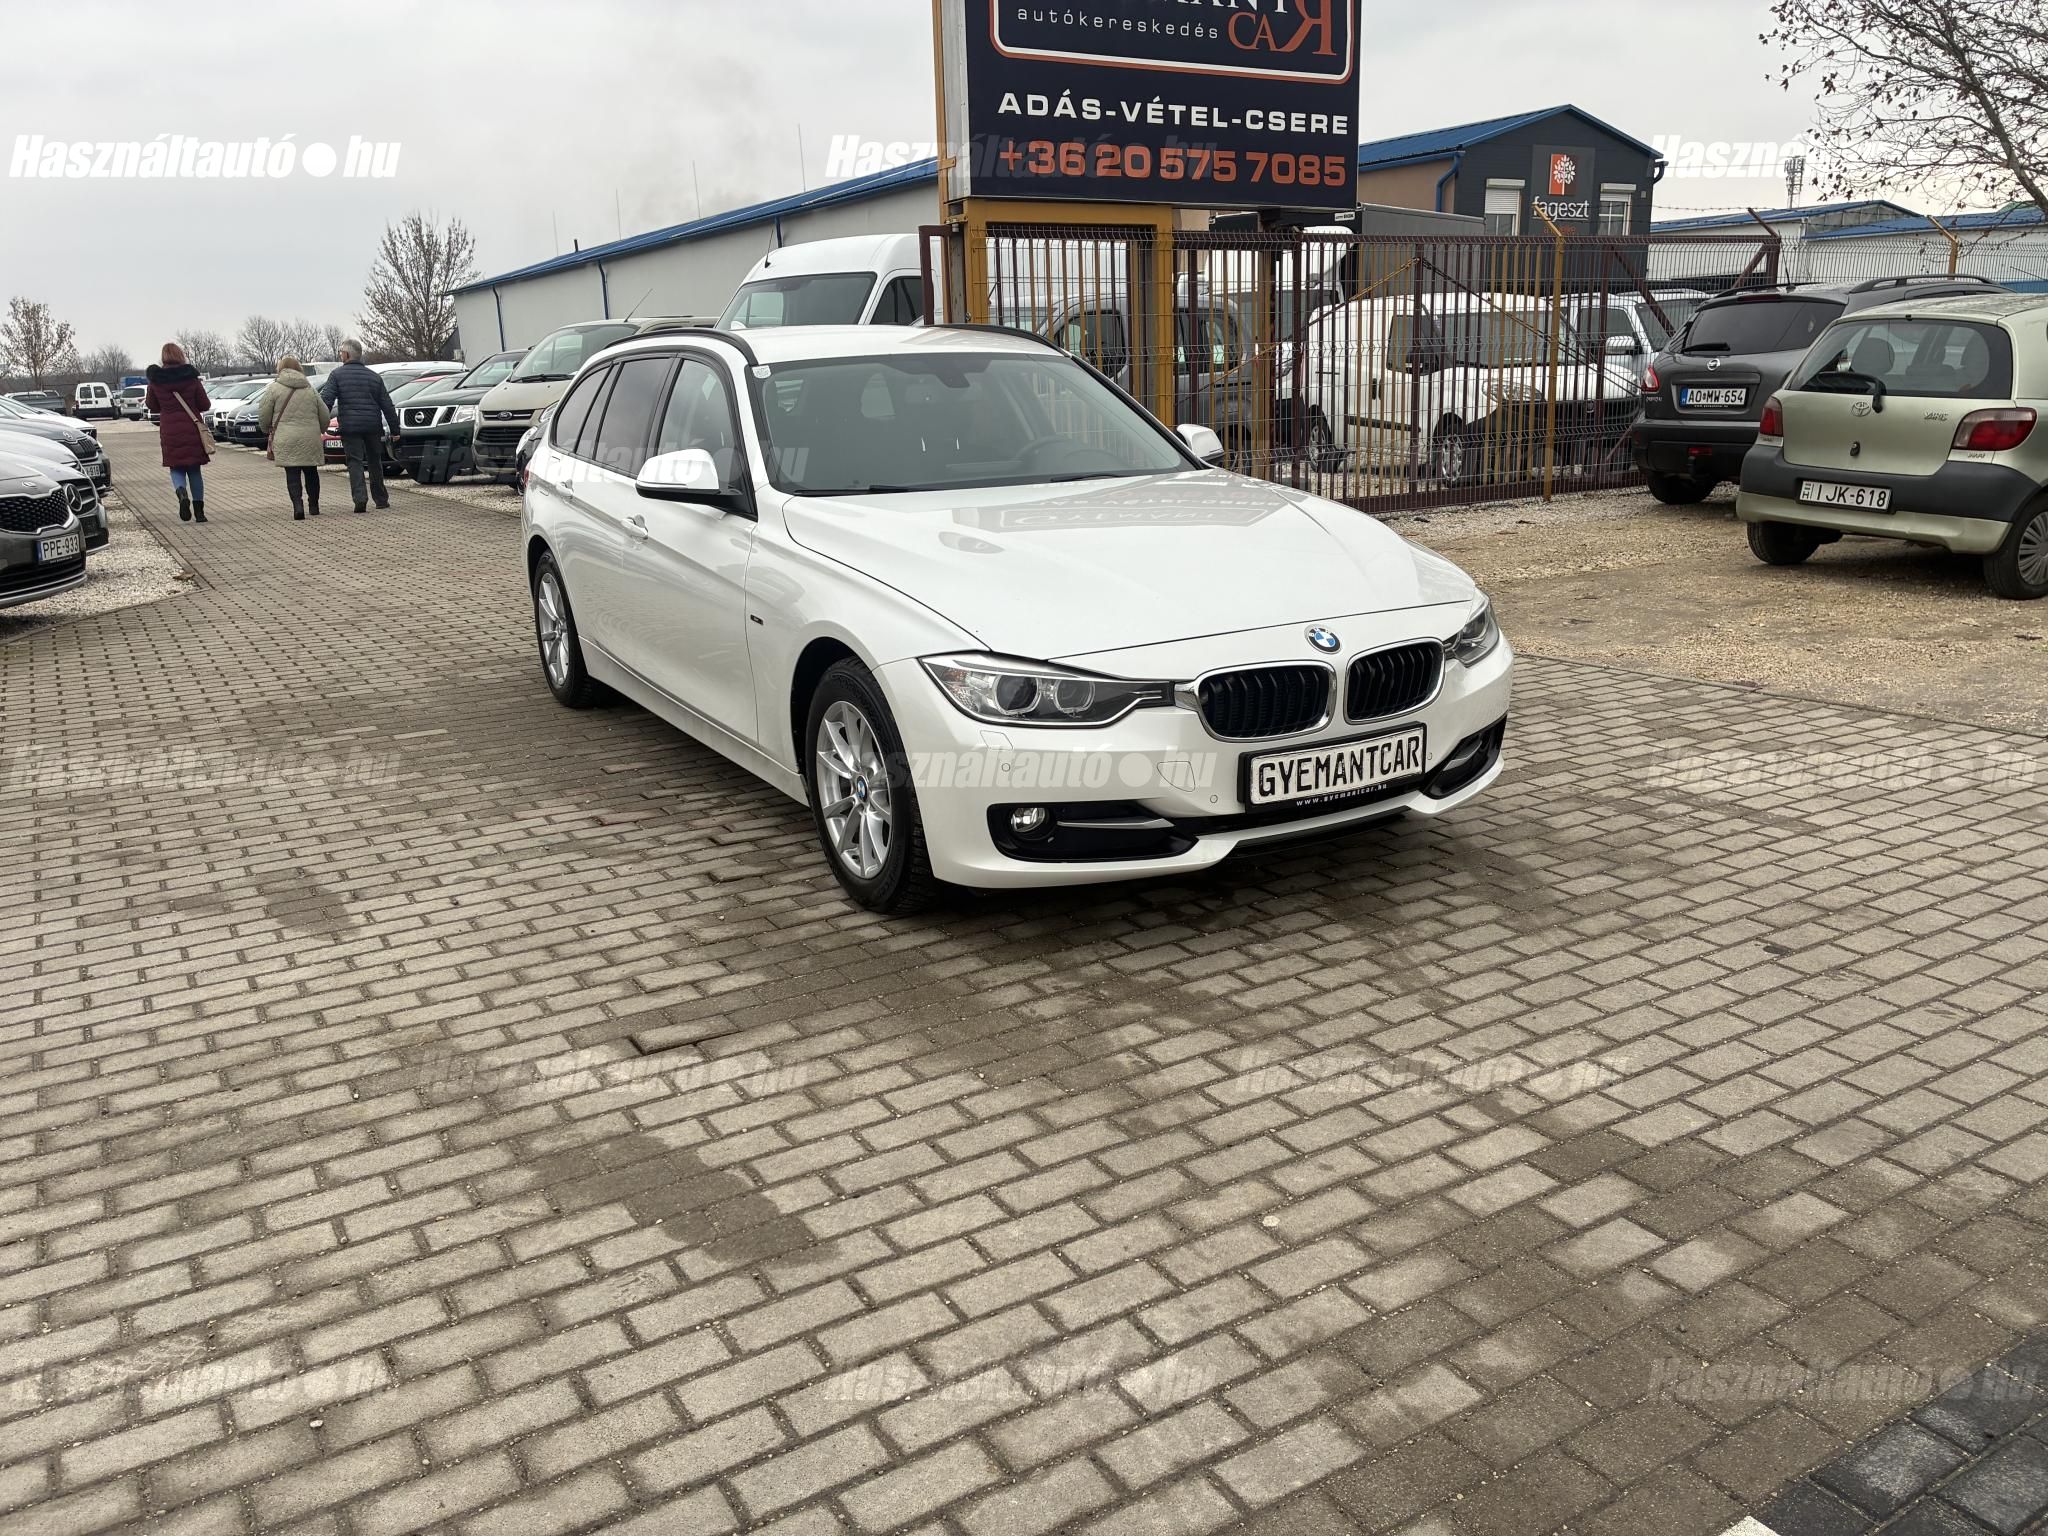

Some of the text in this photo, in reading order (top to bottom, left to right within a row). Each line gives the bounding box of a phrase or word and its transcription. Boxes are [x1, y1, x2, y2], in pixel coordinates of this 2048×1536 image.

[1017, 8, 1218, 39] autókereskedés
[998, 89, 1348, 135] ADÁS-VÉTEL-CSERE
[1000, 140, 1346, 187] +36 20 575 7085
[1532, 196, 1590, 222] fageszt
[1816, 486, 1887, 508] IJK-618
[42, 535, 79, 558] PPE-933
[1258, 735, 1421, 797] GYEMANTCAR
